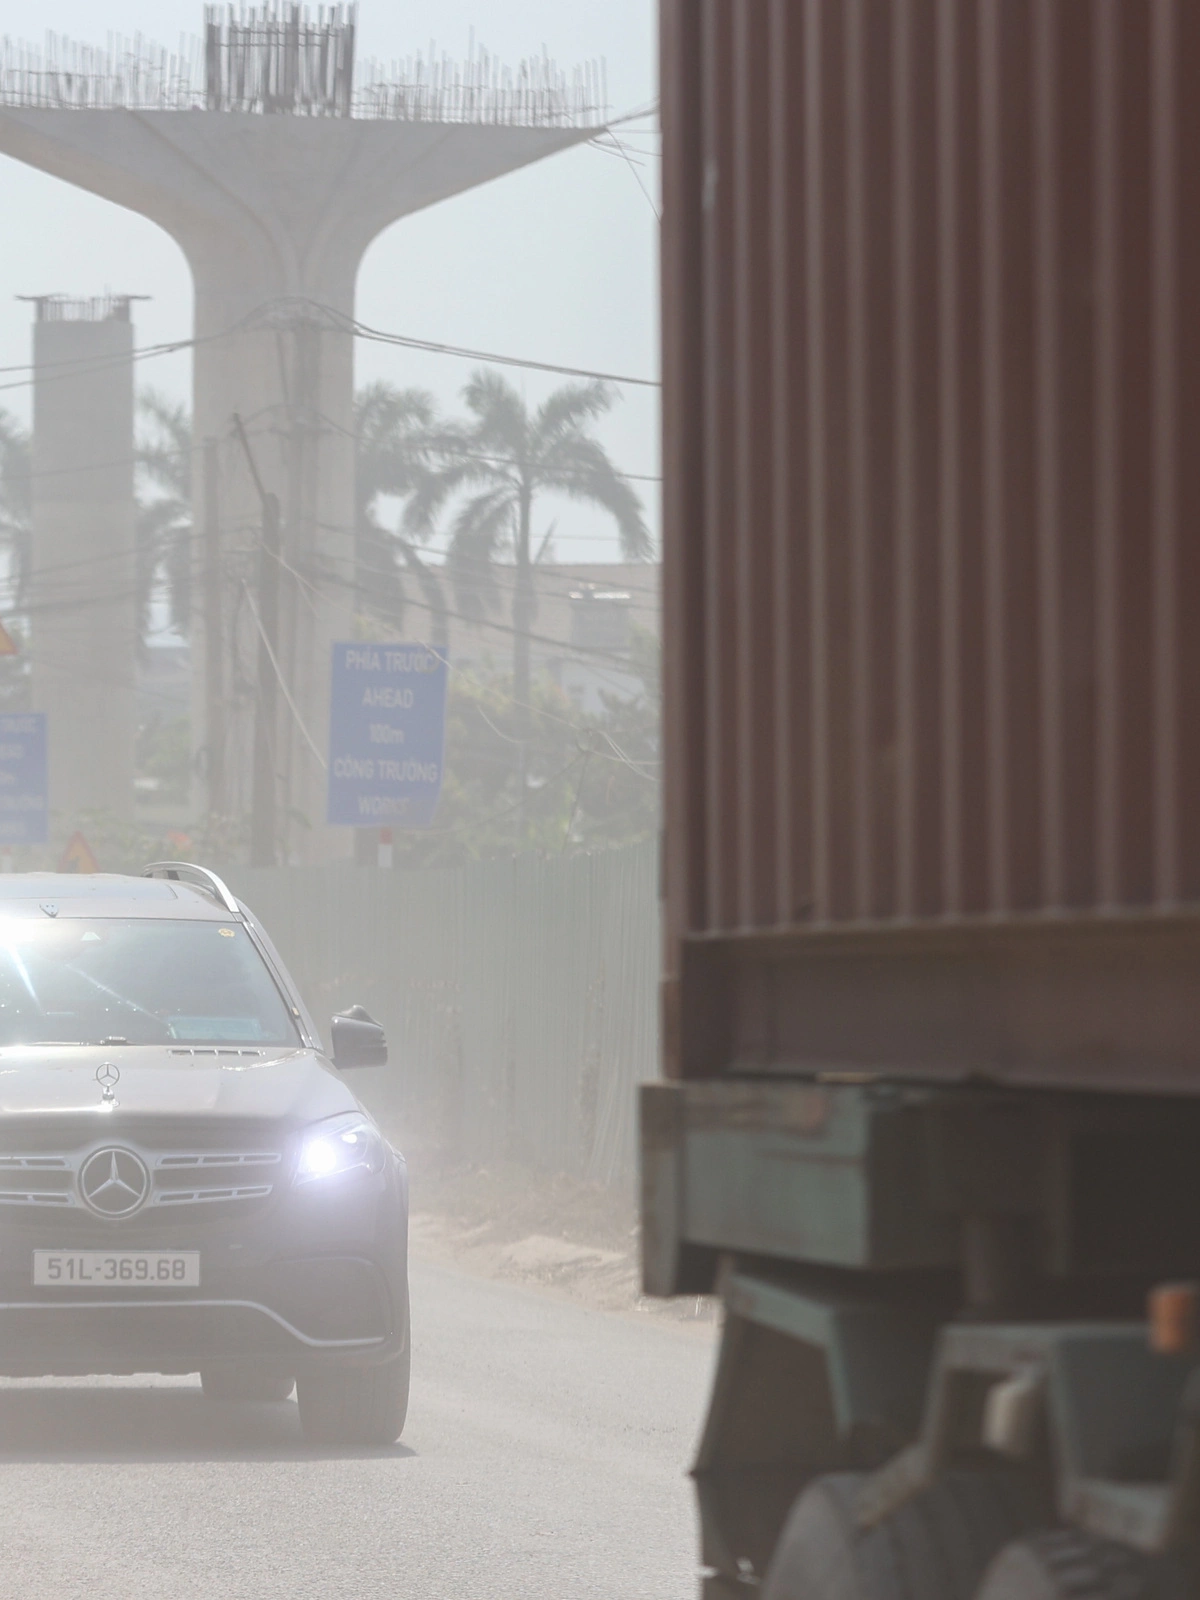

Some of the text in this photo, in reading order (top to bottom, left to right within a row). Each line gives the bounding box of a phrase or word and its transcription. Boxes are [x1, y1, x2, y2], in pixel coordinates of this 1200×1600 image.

[362, 687, 414, 709] AHEAD
[369, 723, 405, 744] 100m
[47, 1257, 187, 1281] 51L-369.68
